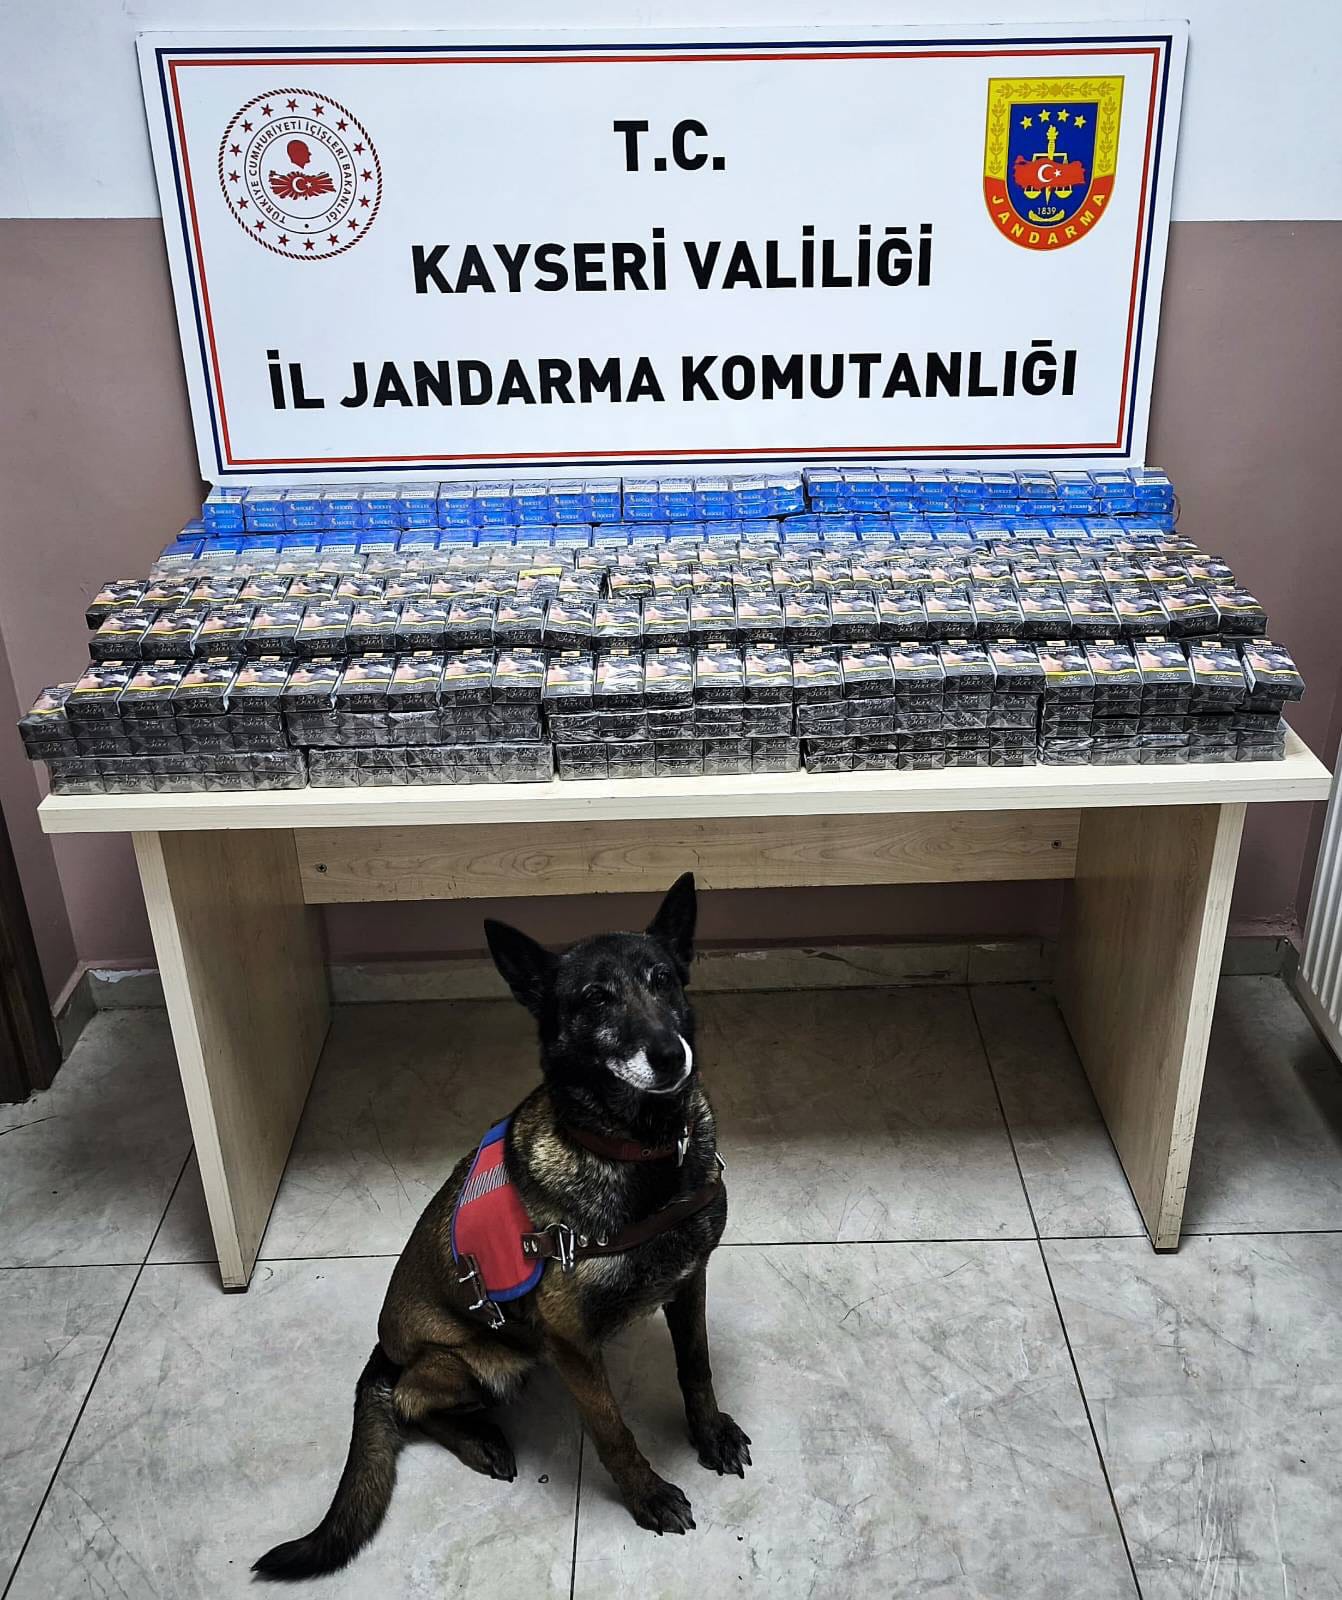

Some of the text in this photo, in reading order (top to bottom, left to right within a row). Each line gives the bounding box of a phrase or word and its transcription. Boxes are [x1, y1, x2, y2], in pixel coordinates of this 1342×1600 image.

[248, 119, 353, 224] TÜRKİYE CUMHURİYETİ İÇİŞLERİ BAKANLIĞI
[613, 119, 726, 172] T.C.
[991, 193, 1106, 245] JANDARMA
[1037, 207, 1057, 215] 1839
[411, 223, 933, 294] KAYSERİ VALİLİĞİ
[266, 339, 1077, 410] İL JANDARMA KOMUTANLIĞI
